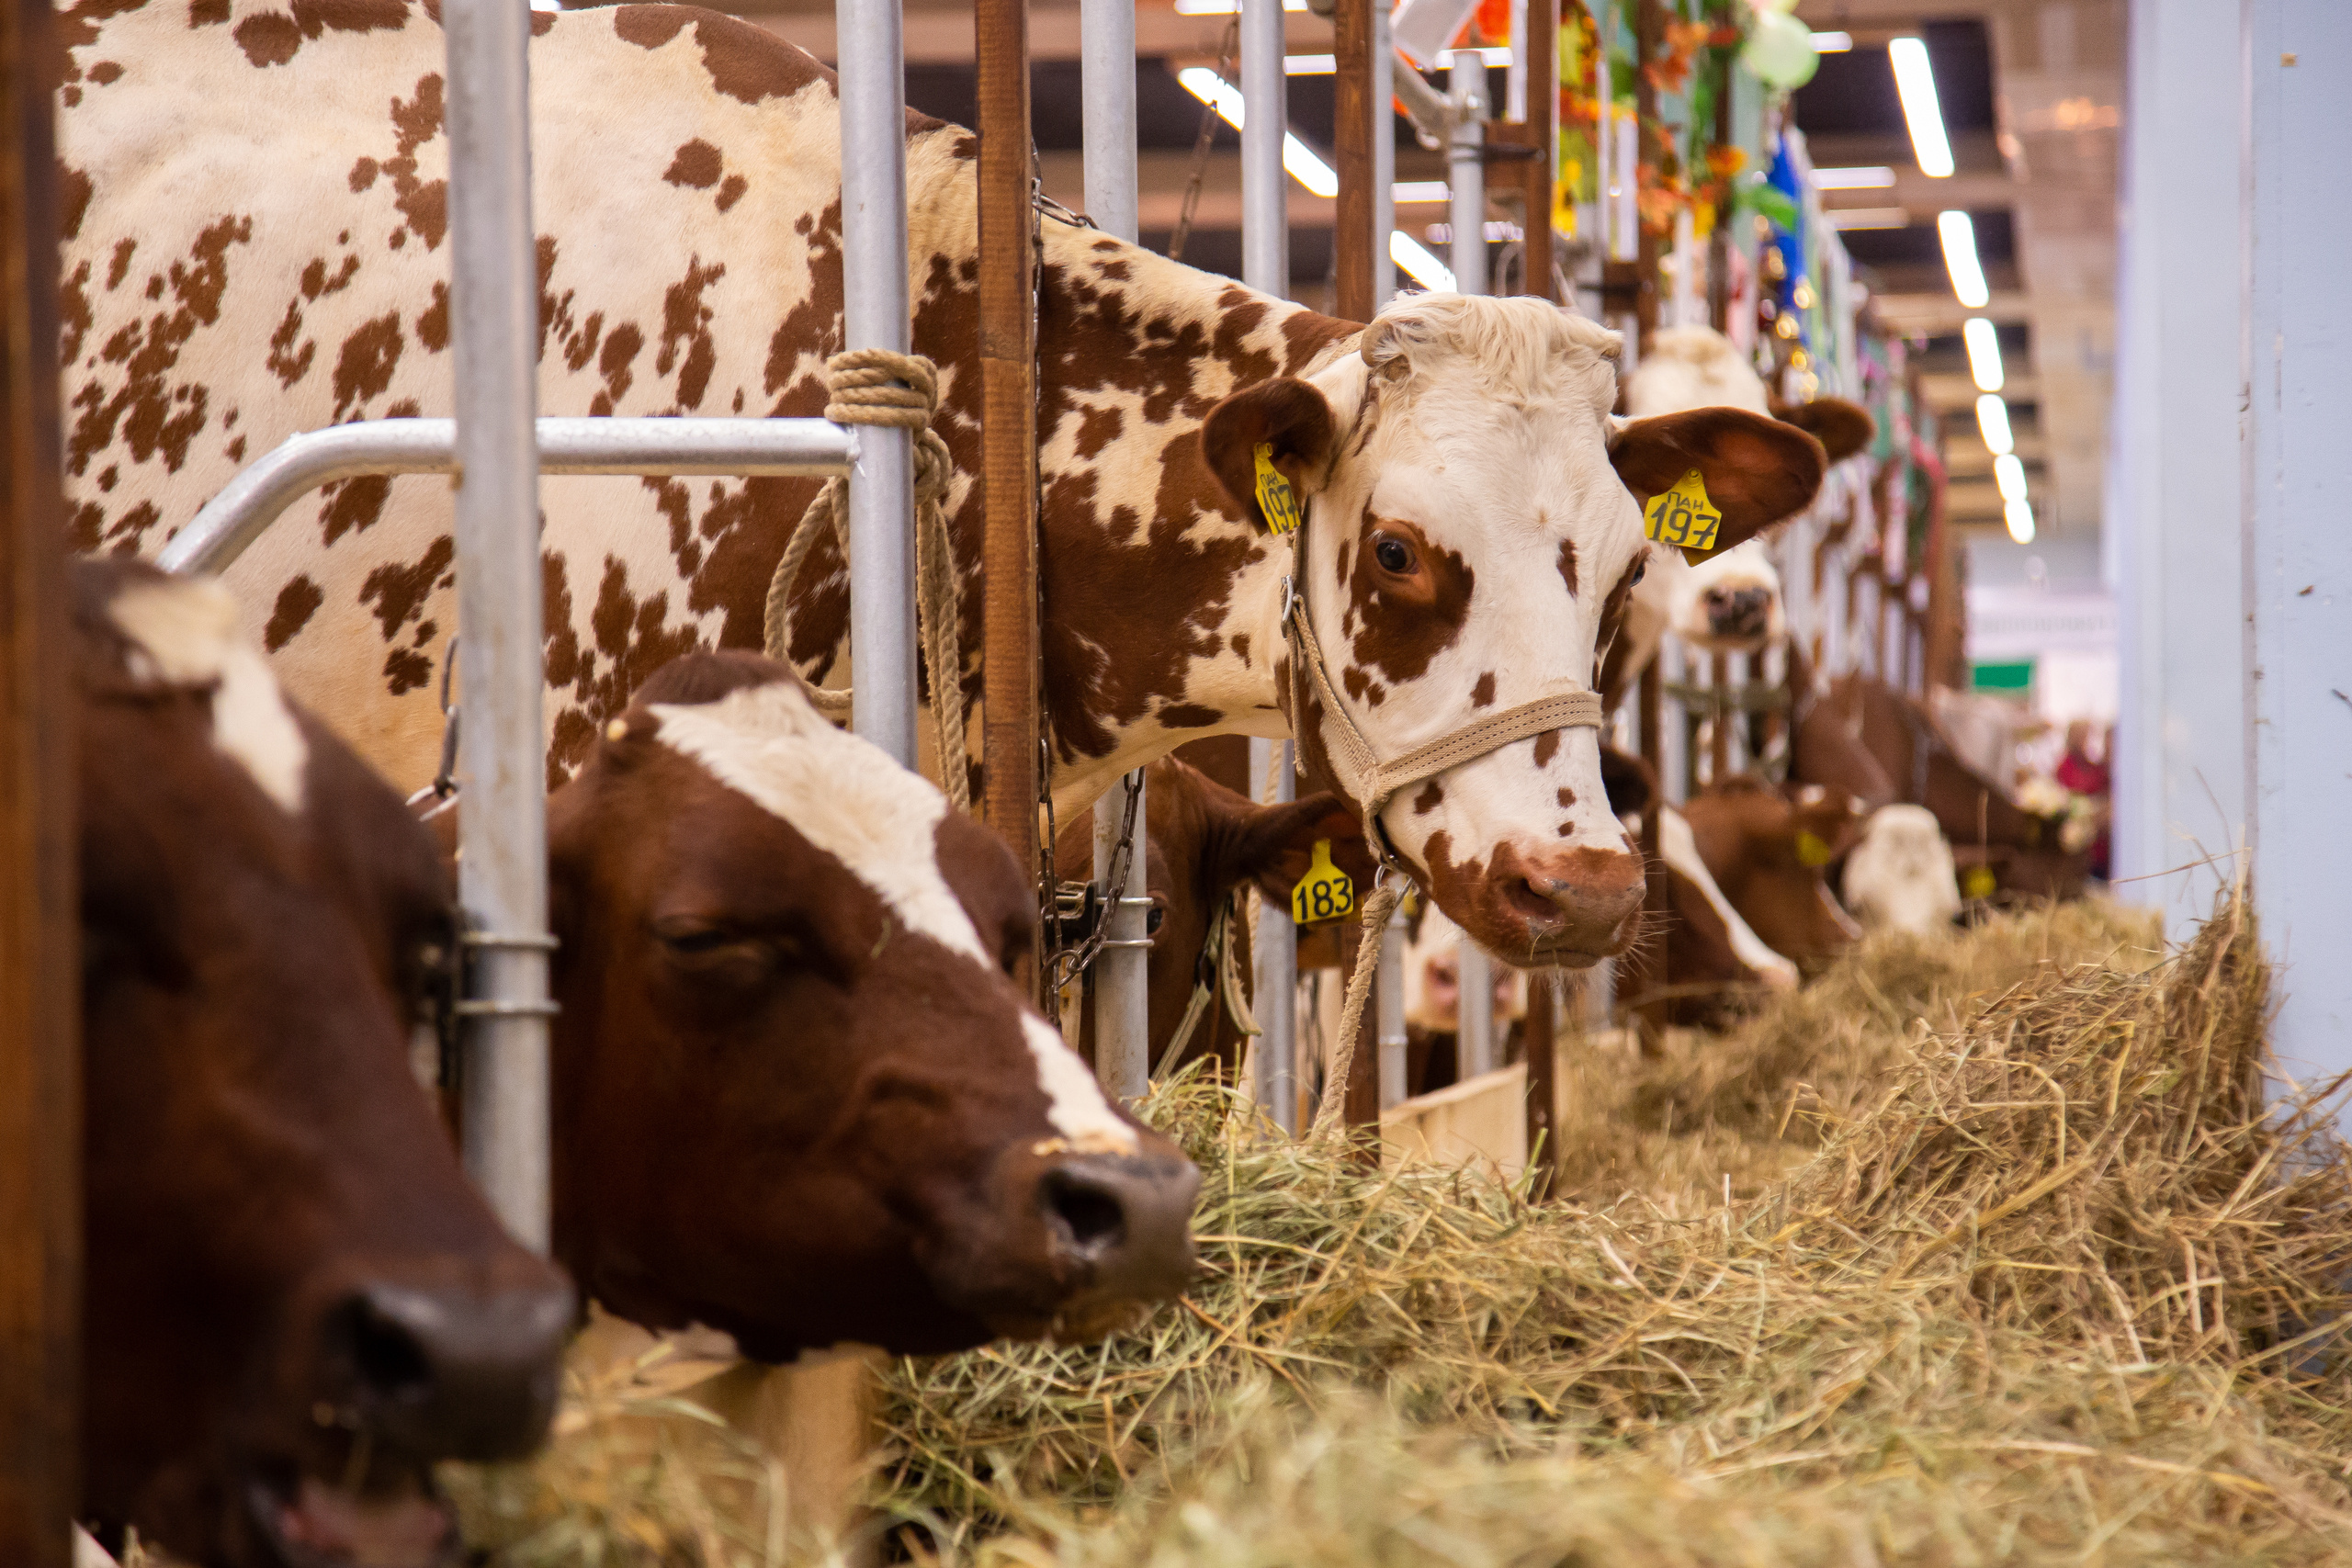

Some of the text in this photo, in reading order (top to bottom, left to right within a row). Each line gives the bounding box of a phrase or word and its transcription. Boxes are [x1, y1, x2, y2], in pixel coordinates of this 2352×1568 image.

[1261, 483, 1300, 535] 197
[1667, 491, 1704, 512] ПАН
[1648, 502, 1719, 548] 197
[1296, 876, 1352, 920] 183
